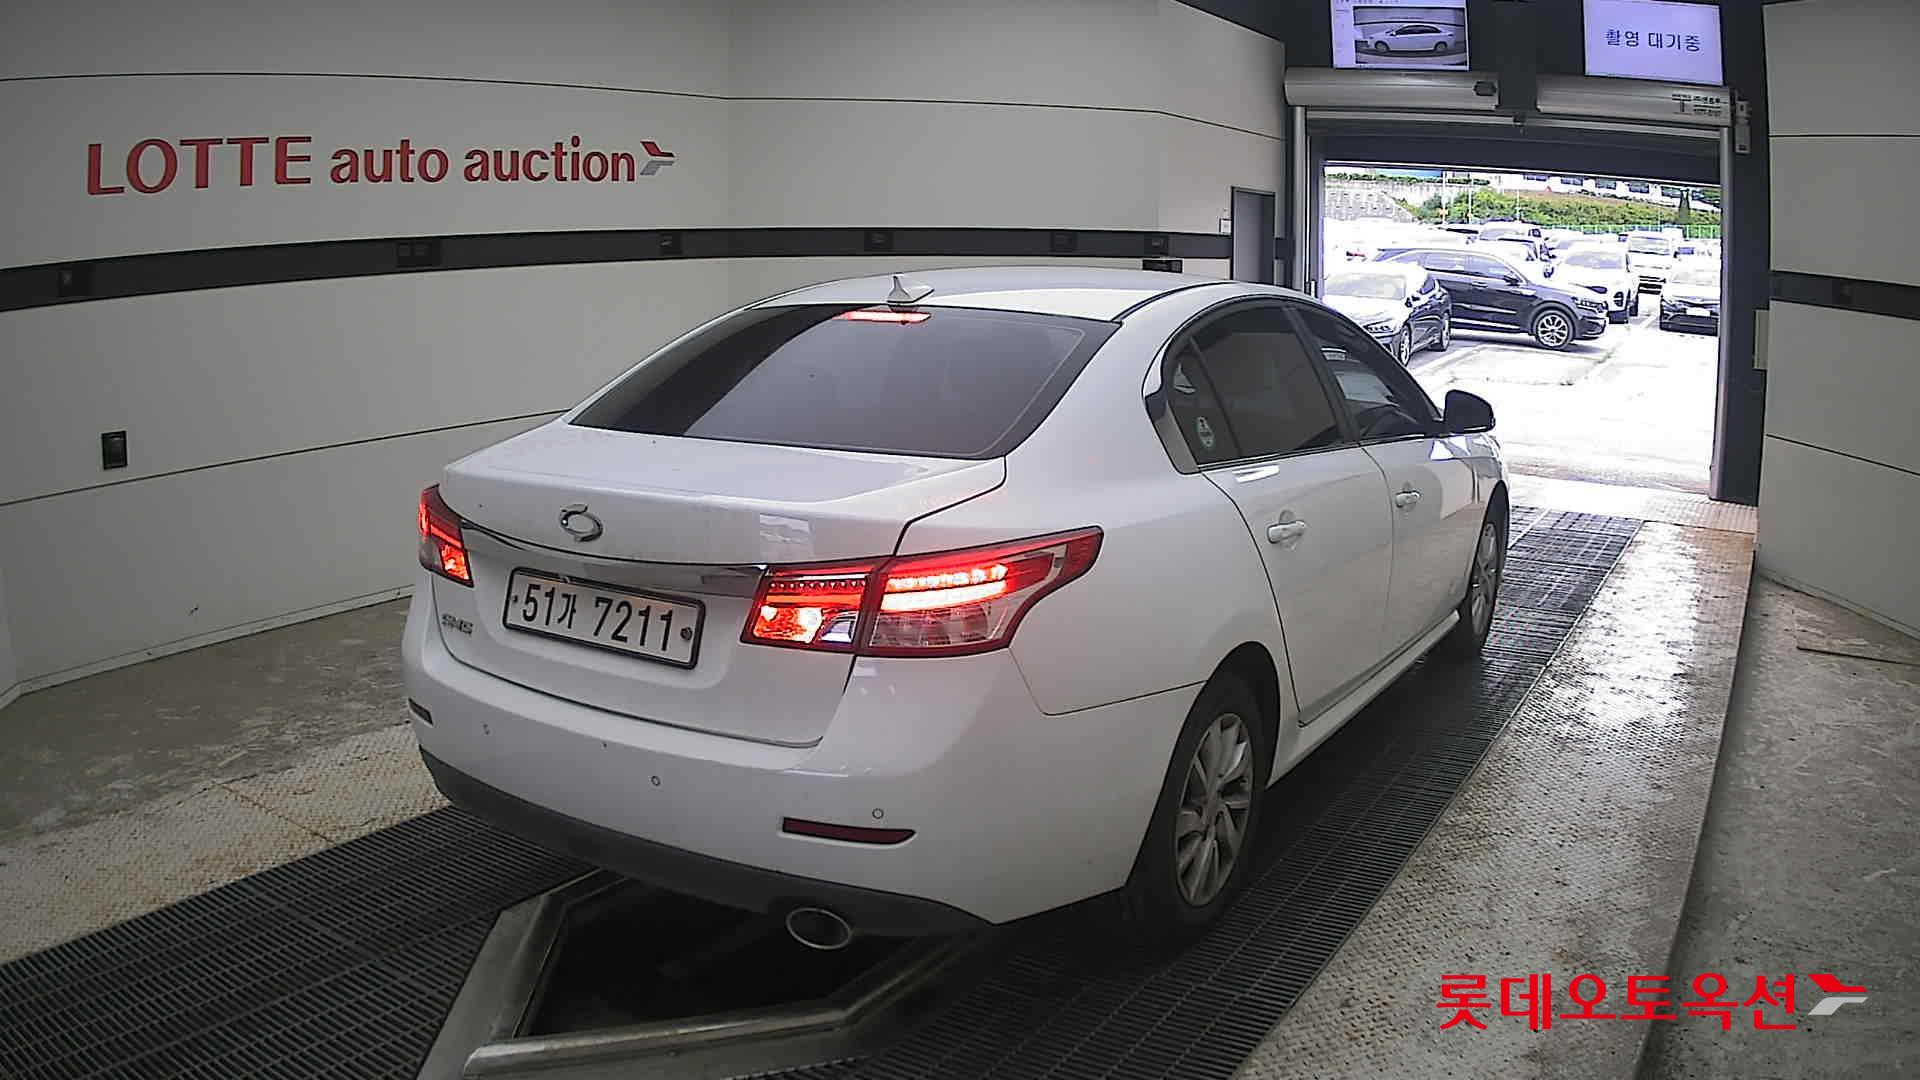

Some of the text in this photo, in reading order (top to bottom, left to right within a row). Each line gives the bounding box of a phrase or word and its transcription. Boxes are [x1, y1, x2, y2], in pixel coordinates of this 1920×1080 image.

[1648, 32, 1701, 52] 대기중
[86, 135, 636, 196] LOTTE auto auction
[521, 583, 674, 652] 51가 7211
